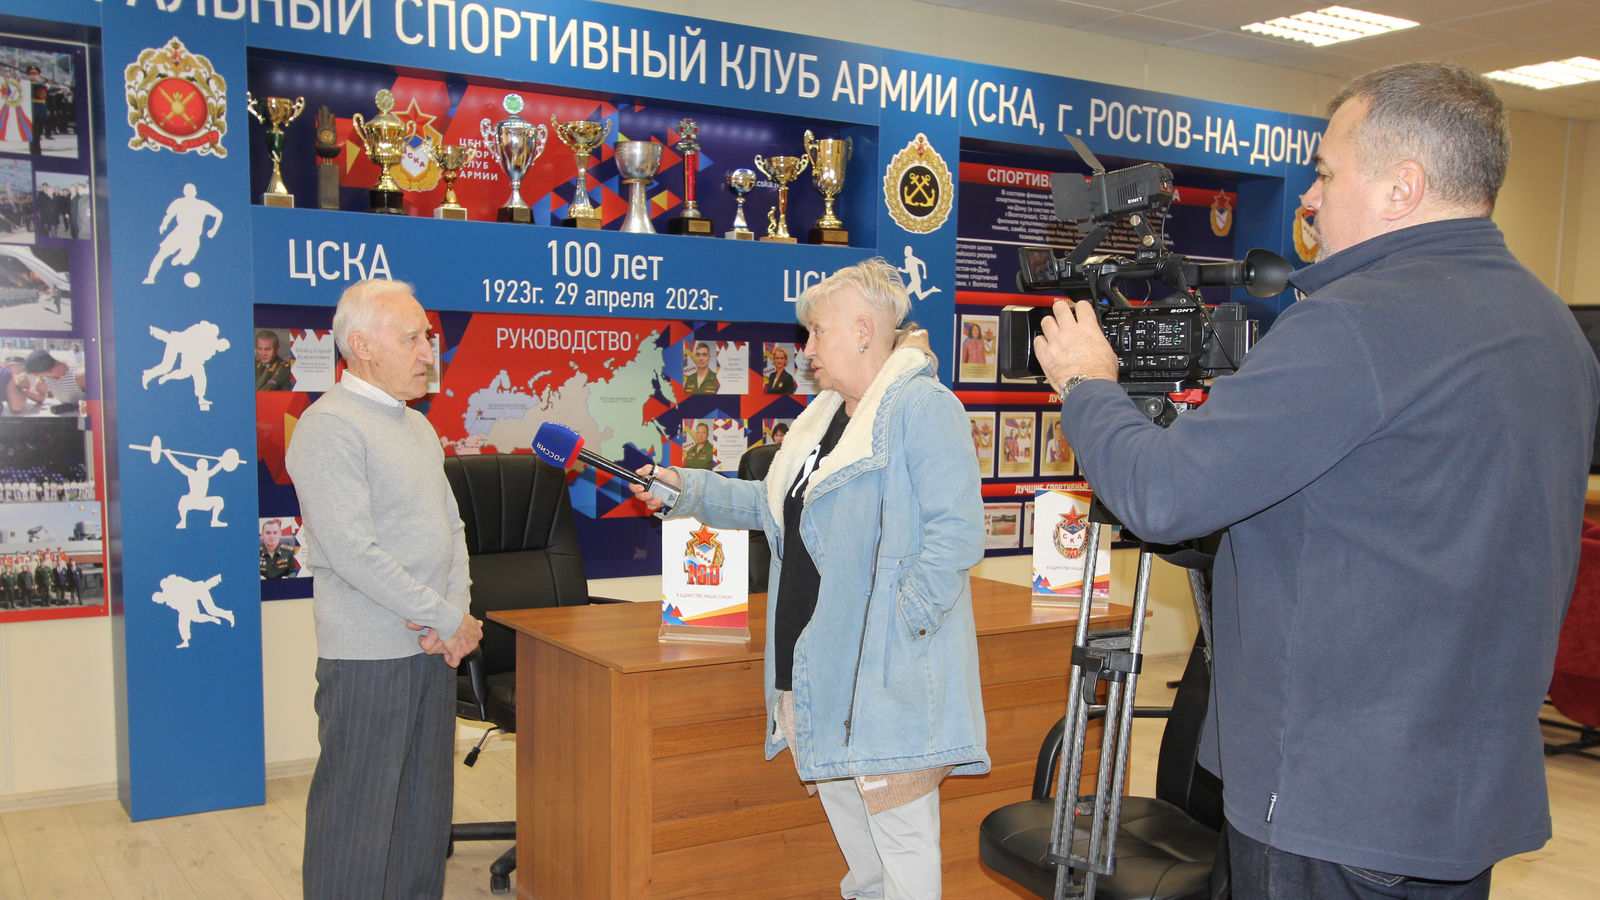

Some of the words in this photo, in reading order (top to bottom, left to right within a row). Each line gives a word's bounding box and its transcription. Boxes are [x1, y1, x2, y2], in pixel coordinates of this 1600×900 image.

[395, 0, 706, 84] СПОРТИВНЫЙ
[720, 41, 820, 98] КЛУБ
[831, 60, 957, 118] АРМИИ
[968, 78, 1045, 135] (СКА,
[1089, 98, 1323, 168] РОСТОВ-НА-ДОНУ
[459, 170, 499, 181] АРМИИ
[462, 160, 489, 170] ЛУБ
[987, 168, 1053, 188] СПОРТИВ
[288, 239, 393, 287] ЦСКА
[547, 239, 601, 278] 100
[611, 253, 664, 281] лет
[482, 278, 545, 304] 1923г.
[554, 282, 579, 306] 29
[585, 289, 654, 313] апреля
[665, 287, 723, 312] 2023г.
[496, 327, 632, 354] РУКОВОДСТВО
[536, 441, 566, 463] РОССИЯ
